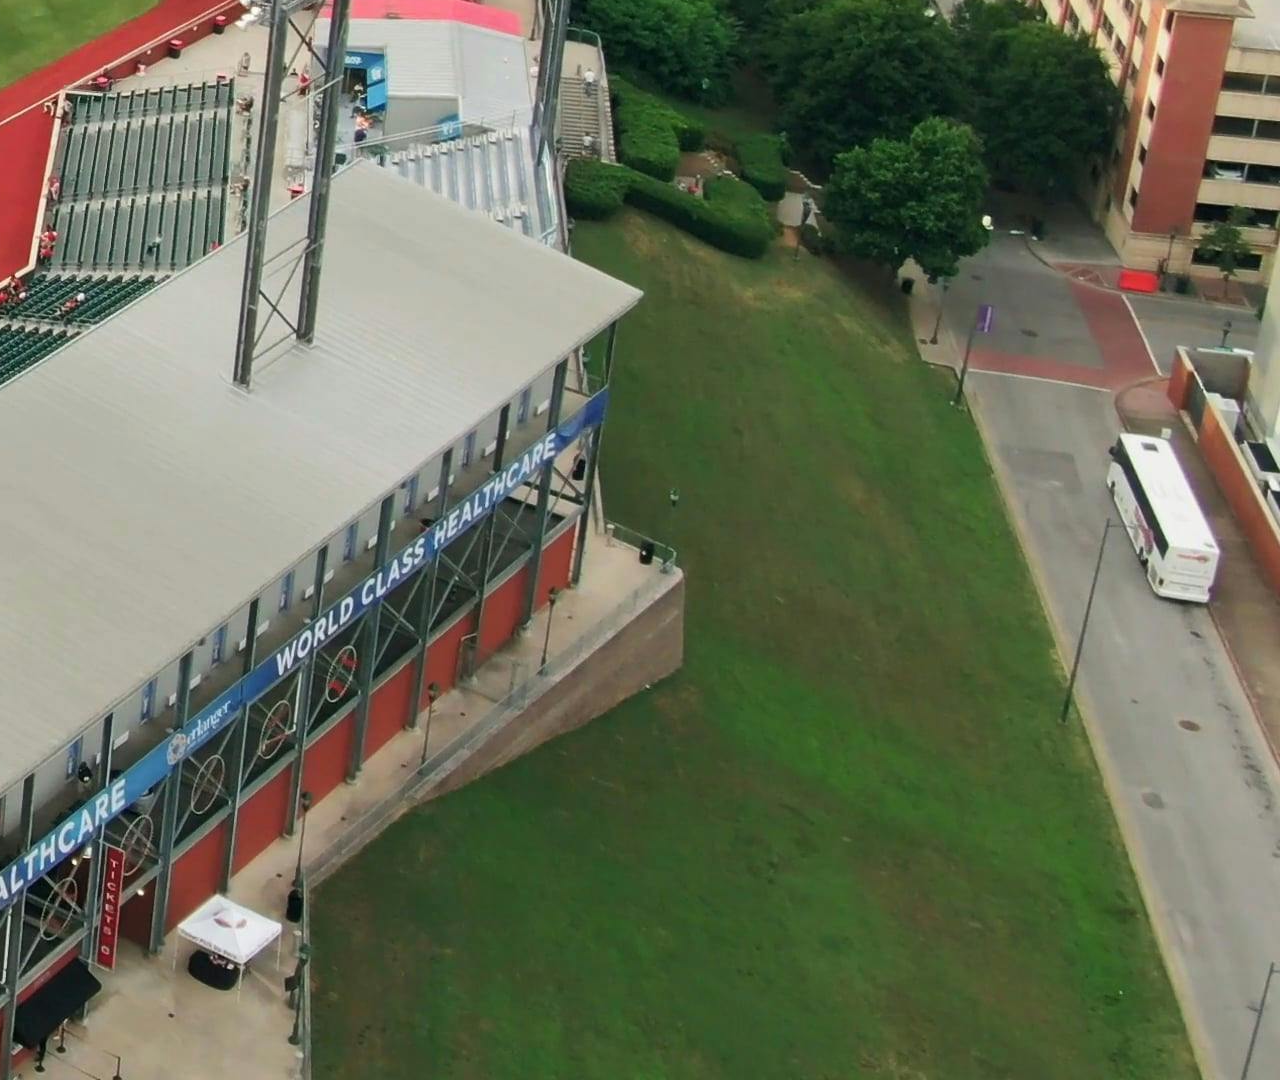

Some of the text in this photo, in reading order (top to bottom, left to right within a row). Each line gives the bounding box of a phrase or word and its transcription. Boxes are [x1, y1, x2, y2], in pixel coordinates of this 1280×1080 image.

[276, 432, 557, 676] WORLD CLASS HEALTHCARE
[187, 700, 232, 745] erlanger
[104, 859, 120, 935] TICKETS
